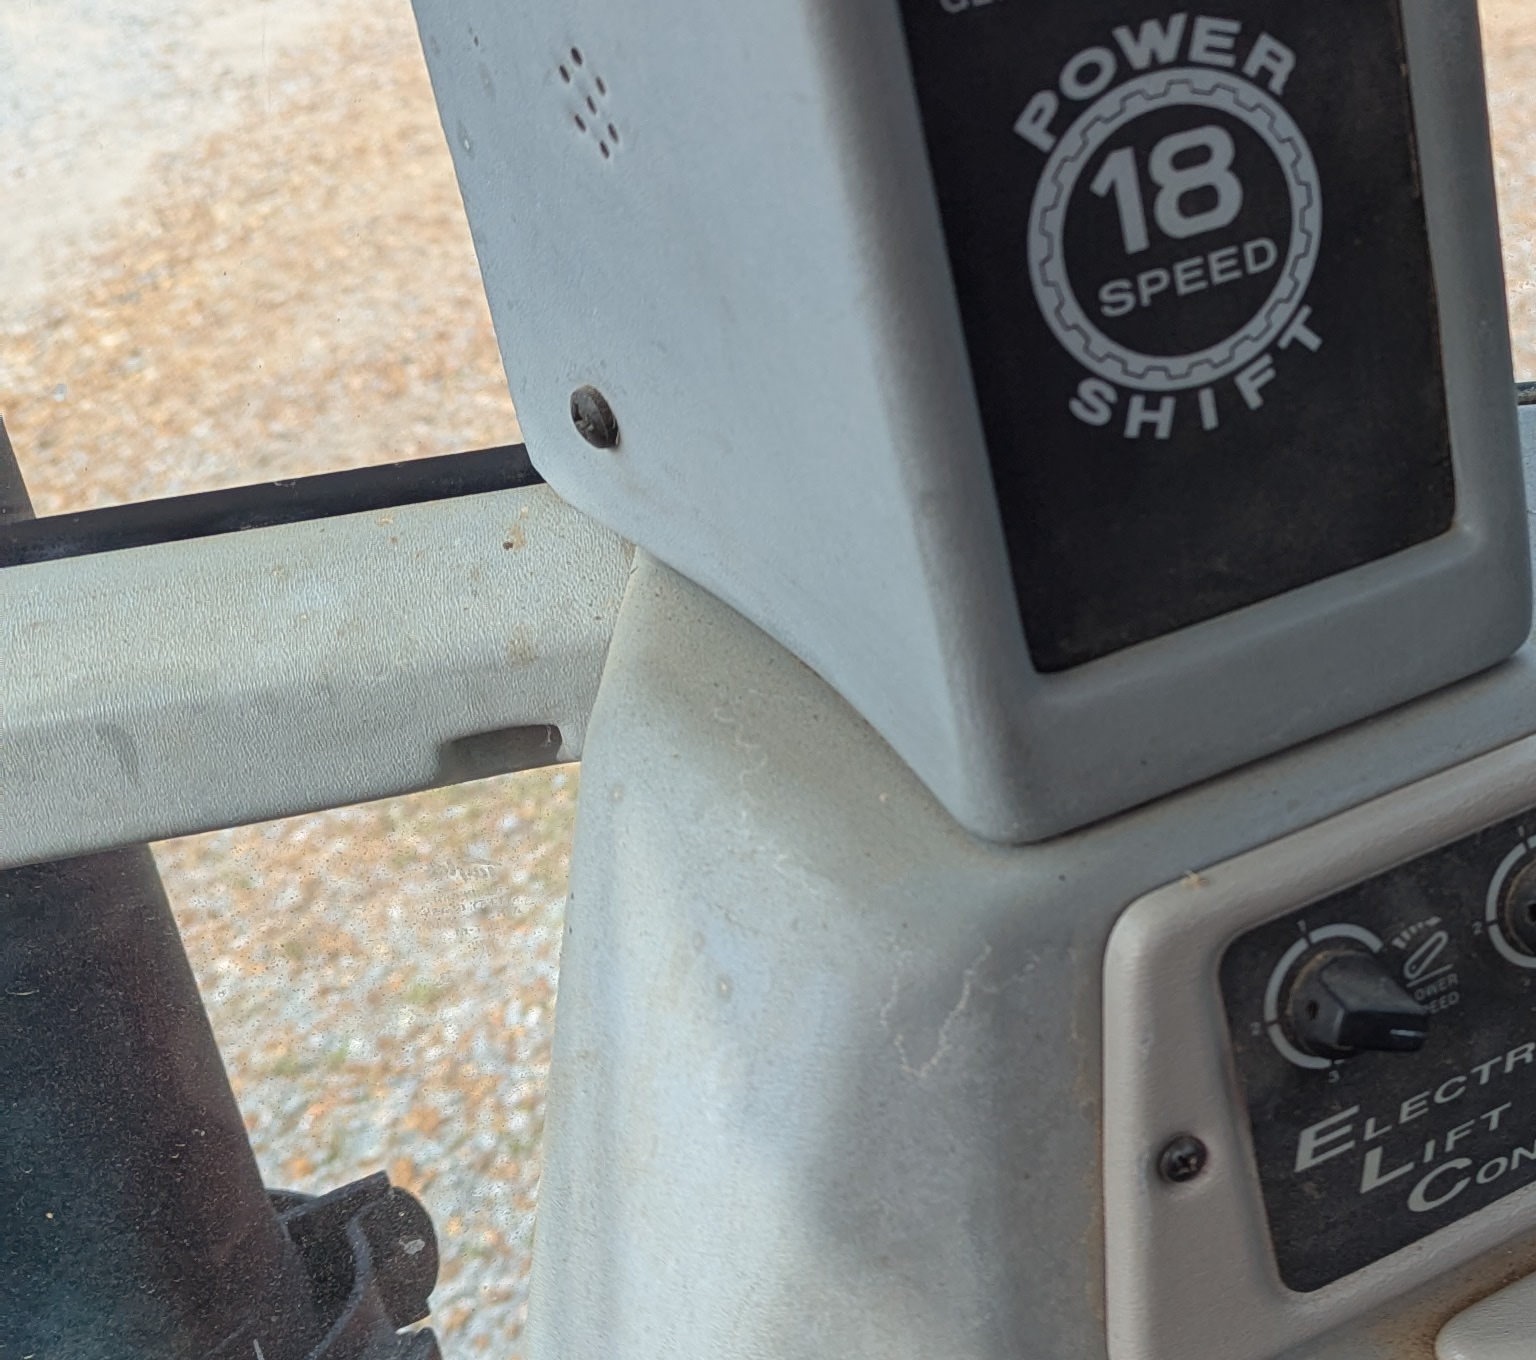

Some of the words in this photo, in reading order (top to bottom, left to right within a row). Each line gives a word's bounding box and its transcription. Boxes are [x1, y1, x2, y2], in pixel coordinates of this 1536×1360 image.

[1013, 12, 1296, 153] POWER
[1089, 124, 1244, 255] 18
[1098, 236, 1278, 318] SPEED
[1069, 305, 1323, 440] SHIFT
[1472, 921, 1483, 936] 2
[1359, 1102, 1512, 1194] LIFT
